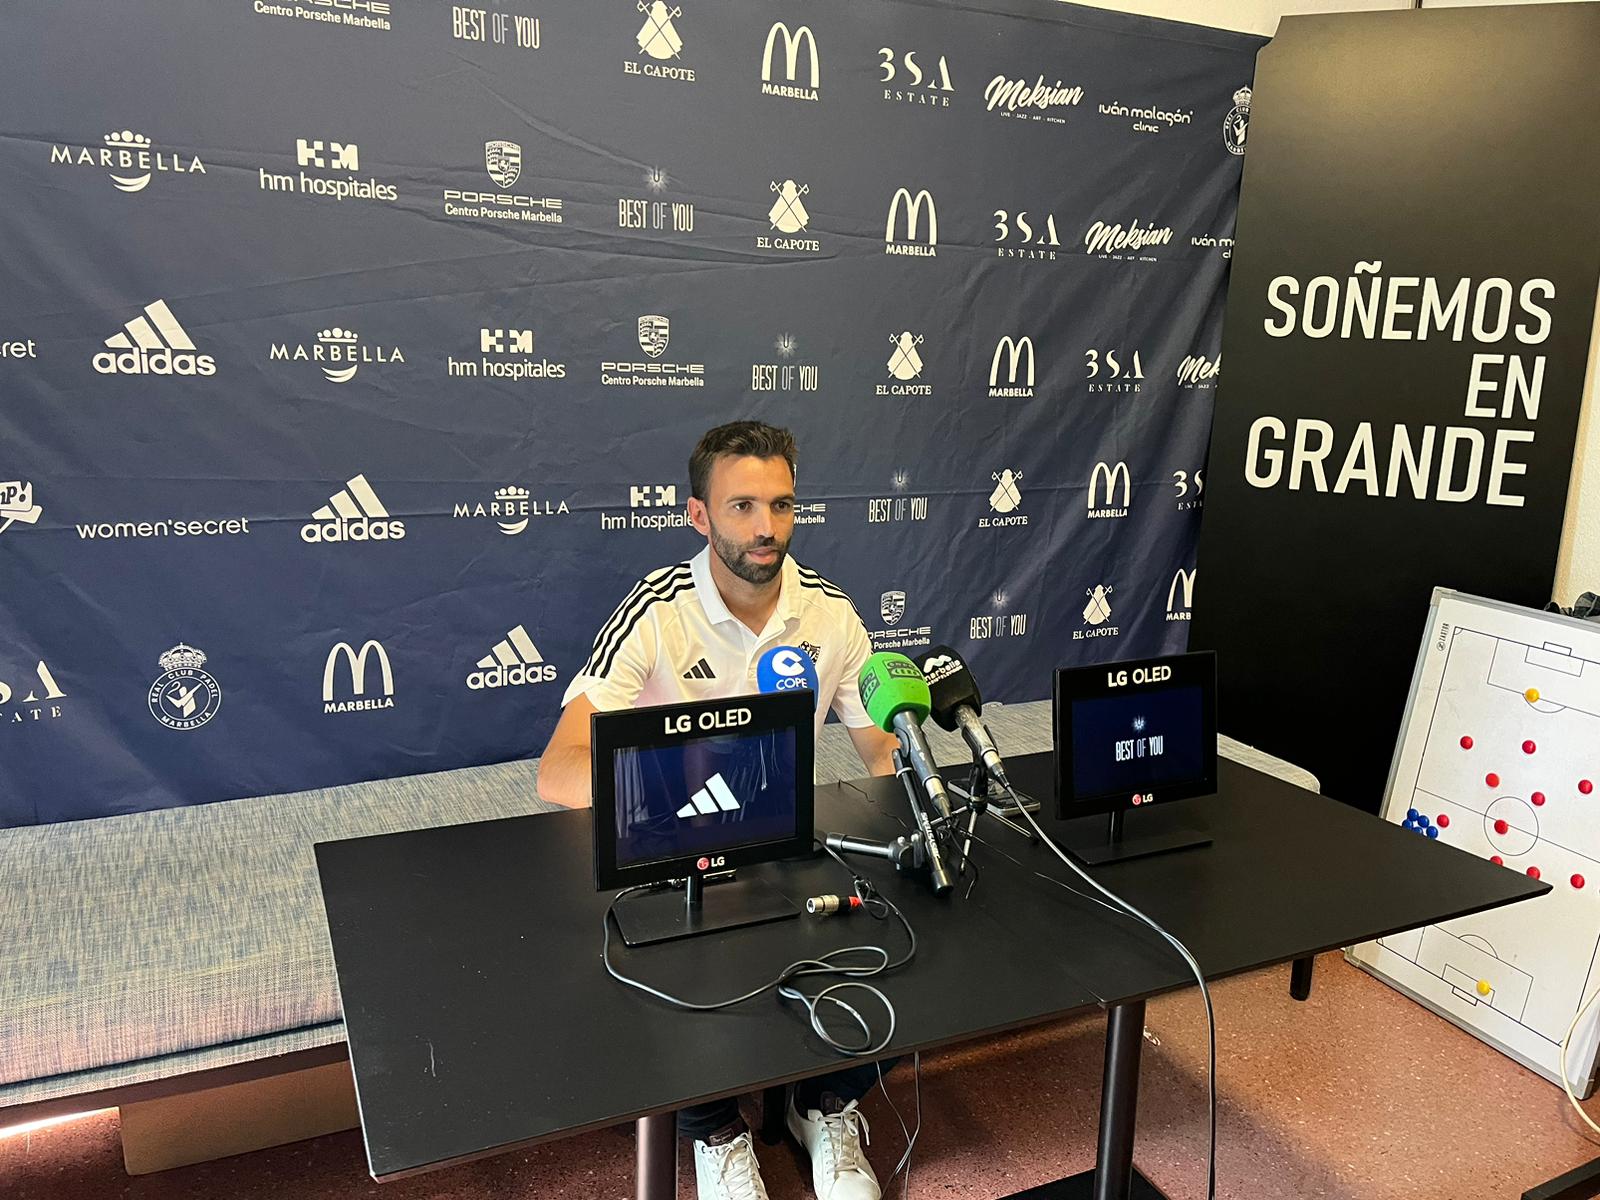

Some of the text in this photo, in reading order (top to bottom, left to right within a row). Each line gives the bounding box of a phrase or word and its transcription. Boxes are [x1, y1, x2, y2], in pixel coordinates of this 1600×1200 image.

[254, 1, 391, 30] Centro Porsche Marbella
[453, 6, 539, 49] BEST OF YOU
[624, 61, 695, 81] EL CAPOTE
[762, 83, 818, 101] MARBELLA
[884, 89, 949, 107] ESTATE
[984, 75, 1084, 111] Meksian
[1133, 121, 1159, 133] clinic
[51, 145, 206, 174] MARBELLA
[260, 168, 397, 200] hm hospitales
[444, 190, 562, 208] PORSCHE
[445, 203, 562, 224] Centro Porsche Marbella
[619, 199, 693, 231] BEST OF YOU
[757, 237, 819, 251] EL CAPOTE
[1085, 218, 1173, 254] Meksian
[886, 244, 936, 257] MARBELLA
[999, 248, 1055, 259] ESTATE
[1264, 261, 1555, 344] SOÑEMOS
[93, 347, 217, 376] adidas
[270, 343, 405, 363] MARBELLA
[449, 357, 565, 381] hm hospitales
[602, 362, 704, 374] PORSCHE
[752, 365, 817, 390] BEST OF YOU
[602, 374, 704, 387] Centro Porsche Marbella
[876, 385, 931, 395] EL CAPOTE
[1089, 384, 1140, 392] ESTATE
[1464, 353, 1547, 420] EN
[988, 387, 1034, 398] MARBELLA
[1244, 416, 1535, 507] GRANDE
[453, 500, 570, 518] MARBELLA
[869, 498, 927, 522] BEST OF YOU
[1087, 508, 1128, 519] MARBELLA
[76, 518, 249, 538] women'secret
[602, 510, 694, 531] hm hospitale
[793, 515, 826, 524] Marbella
[978, 516, 1027, 528] EL CAPOTE
[301, 518, 405, 543] adidas
[970, 614, 1026, 639] BEST OF YOU
[1073, 627, 1118, 639] EL CAPOTE
[873, 640, 900, 649] Porsche
[466, 661, 557, 690] adidas
[776, 677, 808, 691] COPE
[1108, 666, 1171, 687] LG OLED
[151, 683, 164, 703] REAL
[167, 669, 193, 680] CLUB
[323, 697, 394, 713] MARBELLA
[161, 711, 211, 728] MARBELLA
[665, 708, 751, 734] LG OLED
[1116, 736, 1163, 761] BEST OF YOU
[1142, 794, 1153, 802] LG
[711, 857, 724, 867] LG
